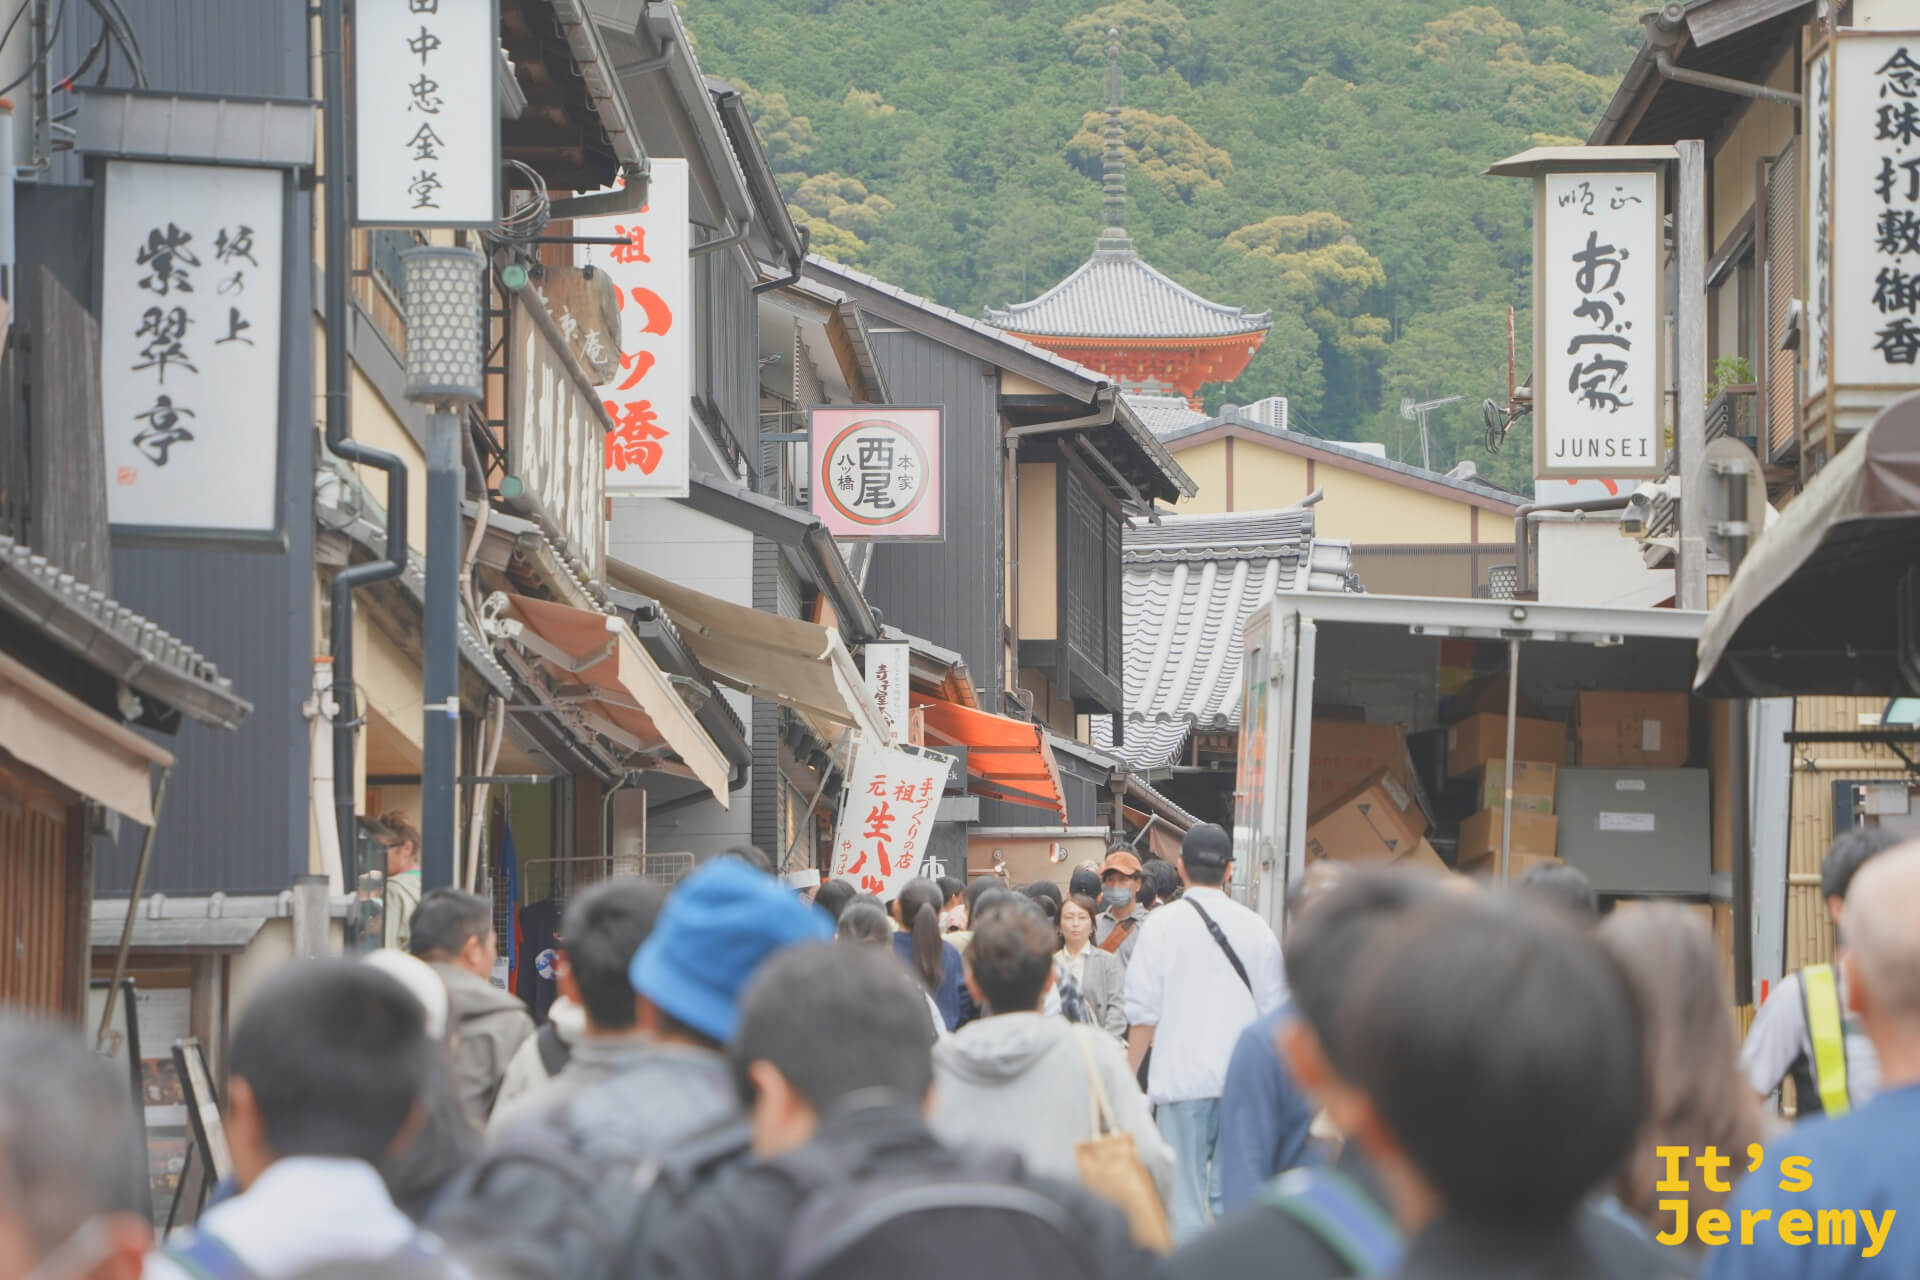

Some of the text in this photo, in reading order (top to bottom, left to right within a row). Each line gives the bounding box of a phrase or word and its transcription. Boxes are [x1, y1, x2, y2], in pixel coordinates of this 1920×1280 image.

[213, 225, 258, 346] 坂の上
[1567, 230, 1633, 414] おかべ家
[131, 222, 201, 468] 紫翠亭
[852, 437, 896, 510] 西尾
[897, 455, 915, 491] 本家
[1555, 438, 1648, 458] JUNSEI
[866, 774, 916, 804] 元祖
[895, 777, 934, 870] 手づくりの店
